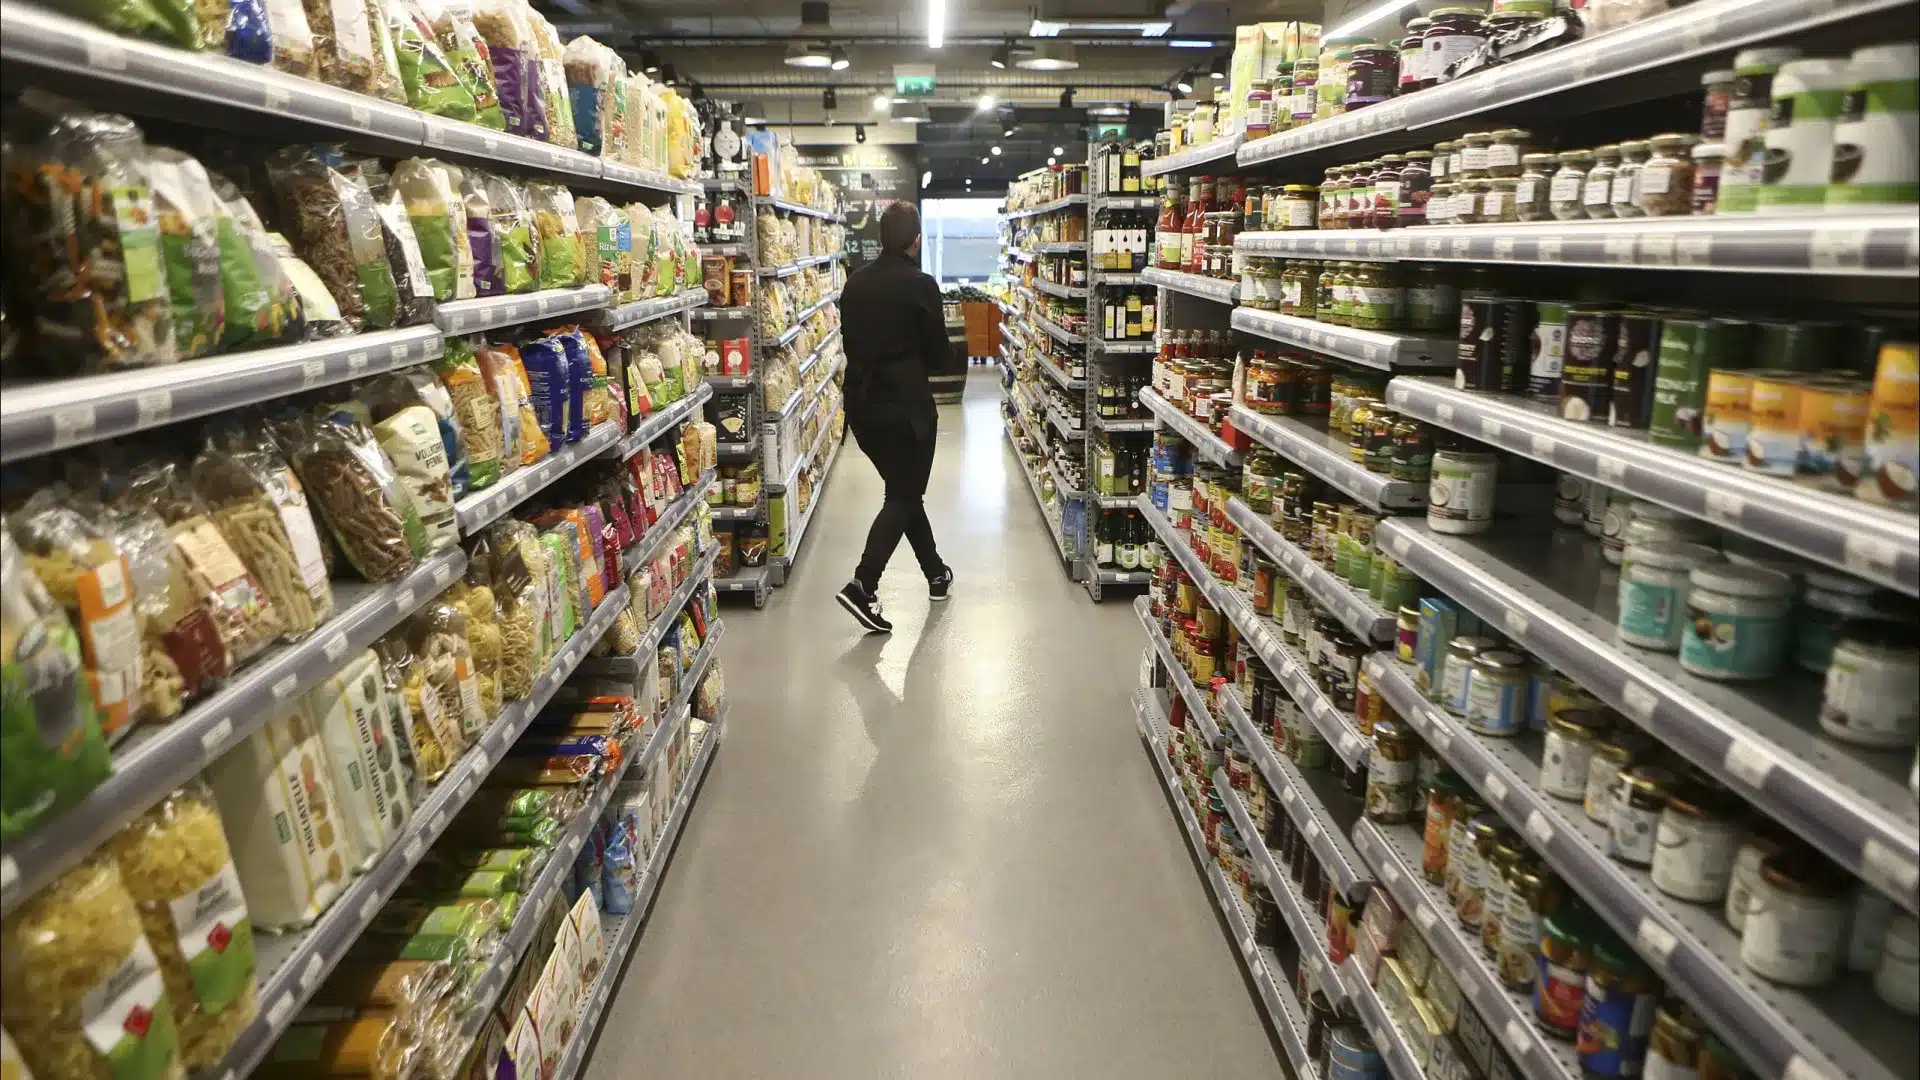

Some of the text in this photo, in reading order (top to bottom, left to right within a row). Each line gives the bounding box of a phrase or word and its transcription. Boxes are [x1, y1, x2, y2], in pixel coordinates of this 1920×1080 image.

[845, 239, 860, 253] 12
[289, 773, 316, 855] TAGLIATELLE
[365, 748, 387, 821] TAGLIATELLE
